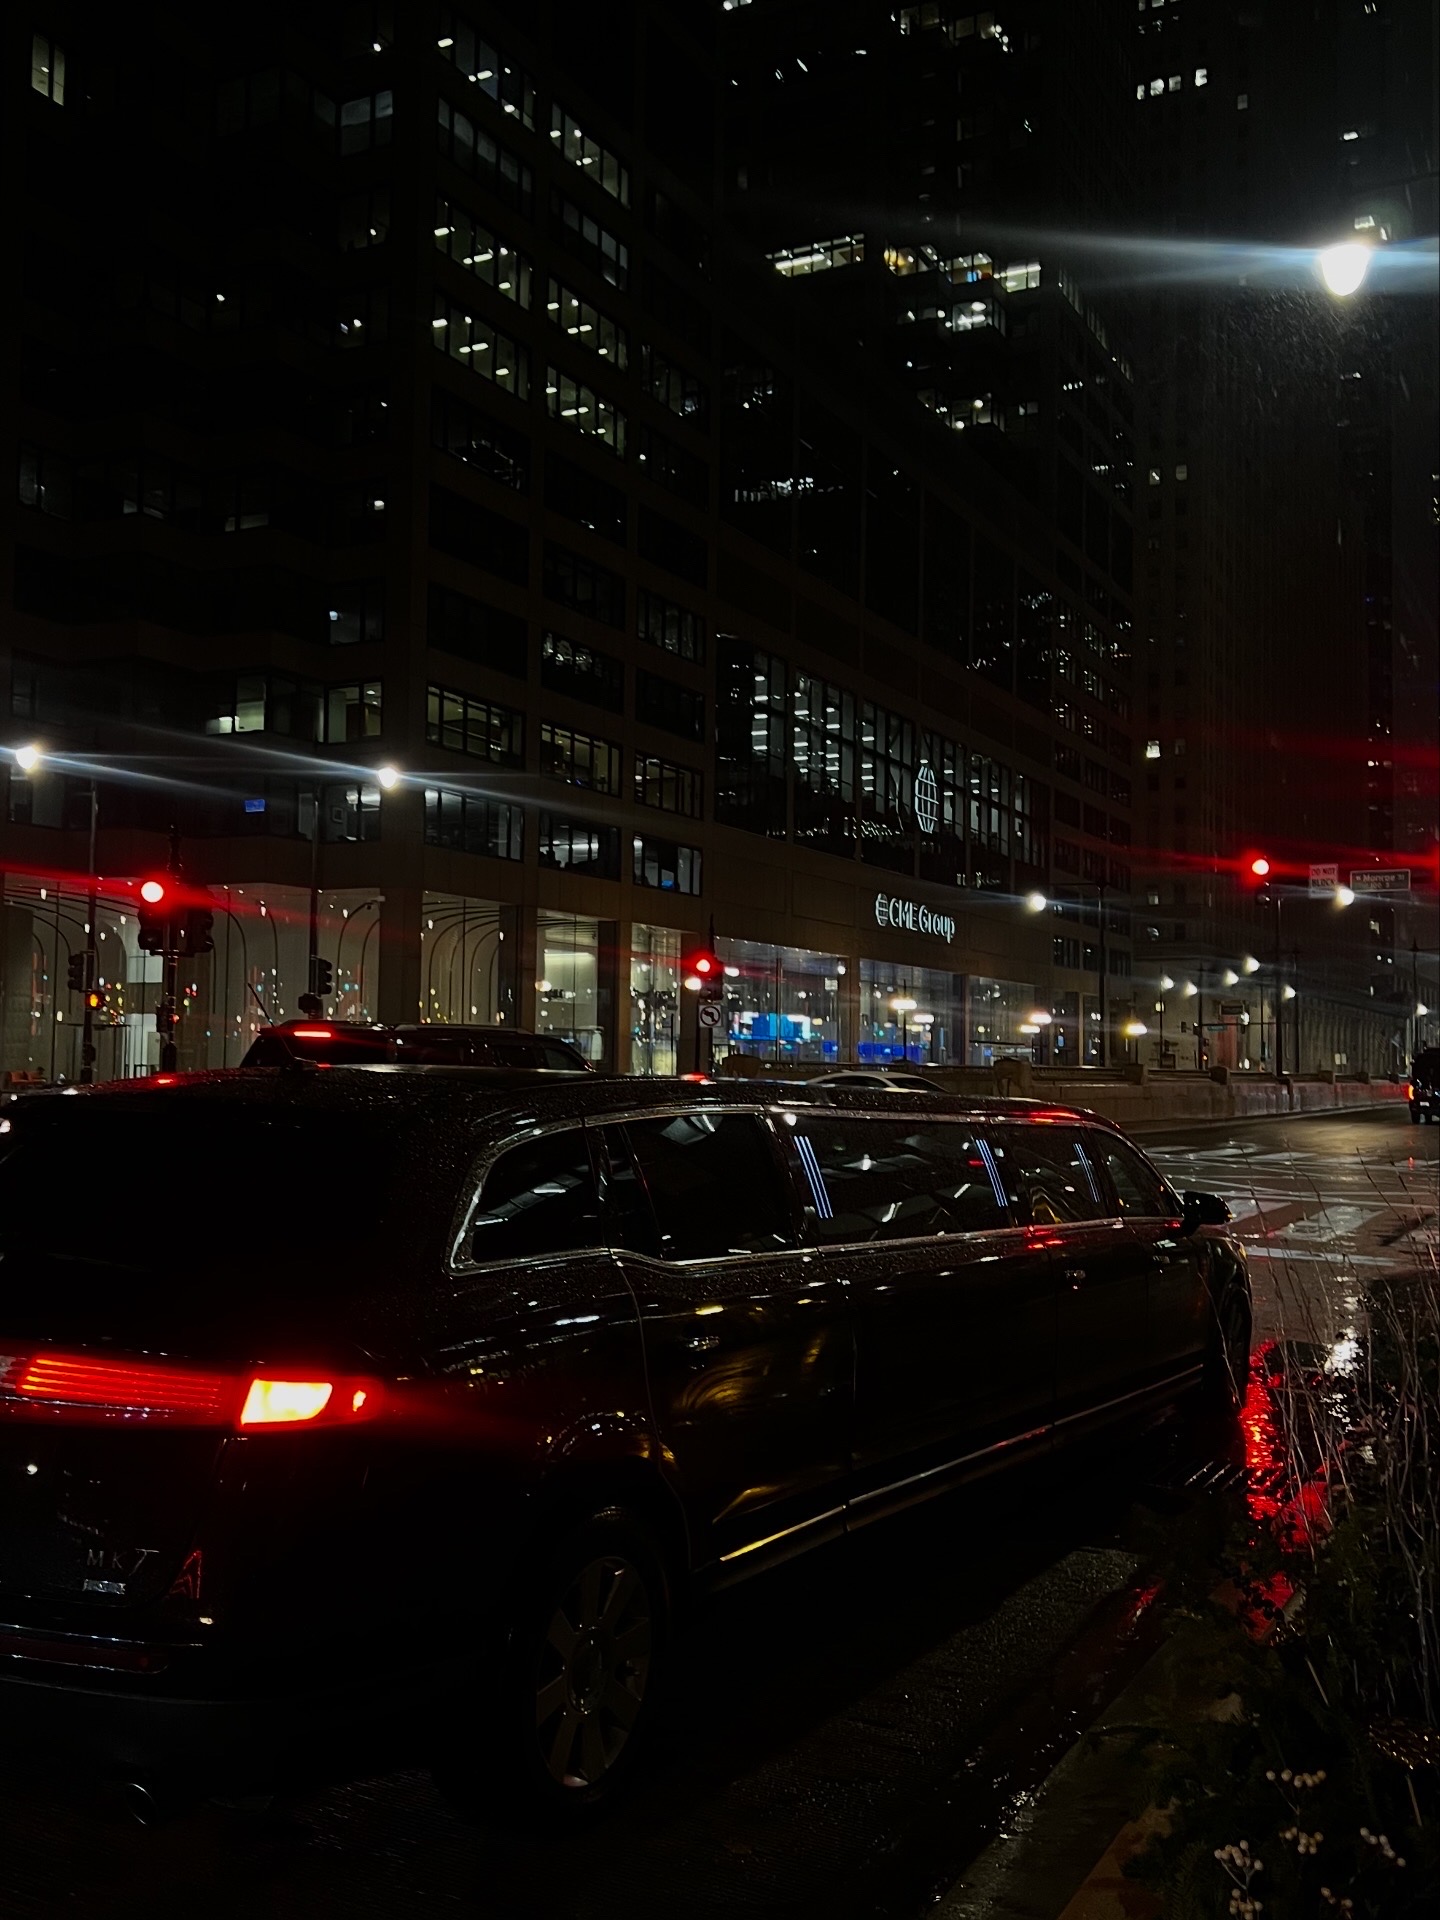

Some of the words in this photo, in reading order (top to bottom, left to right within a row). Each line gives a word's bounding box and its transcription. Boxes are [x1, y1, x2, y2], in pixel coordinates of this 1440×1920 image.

[1362, 873, 1396, 882] Monroe
[889, 897, 918, 931] CME
[918, 904, 955, 944] Group
[87, 1548, 160, 1576] MKT
